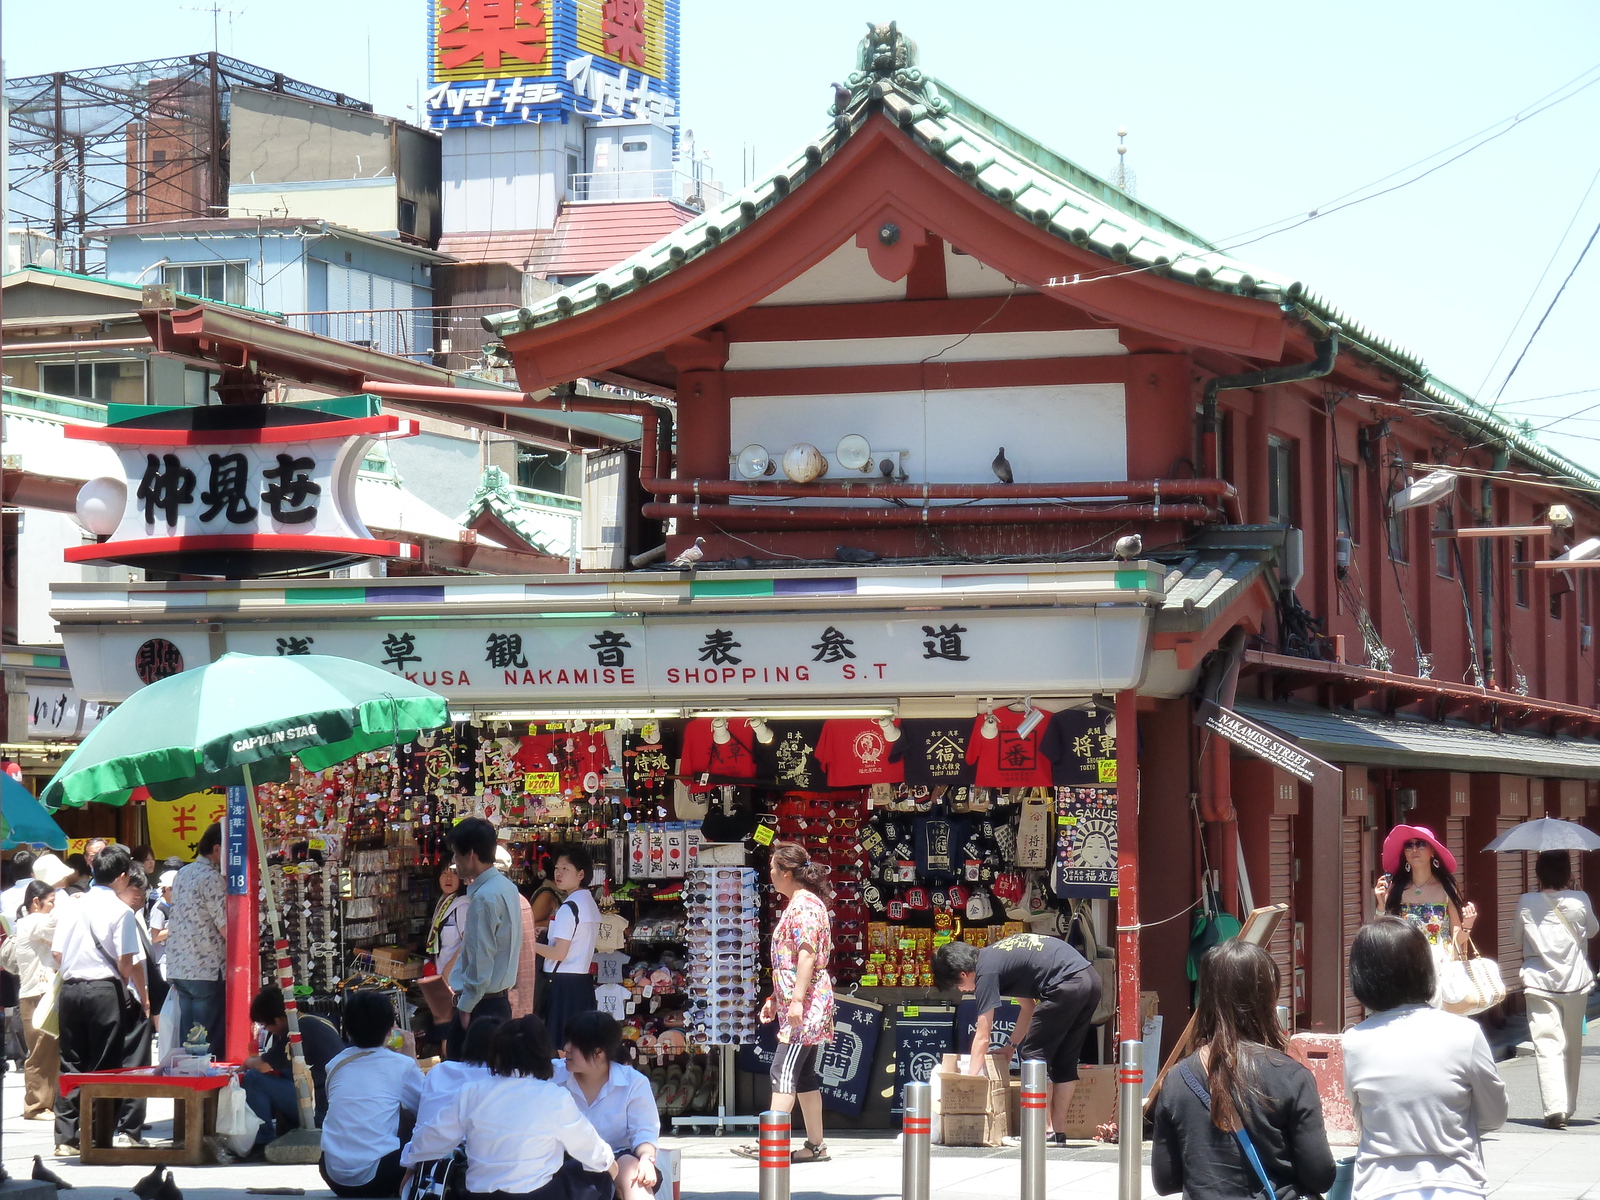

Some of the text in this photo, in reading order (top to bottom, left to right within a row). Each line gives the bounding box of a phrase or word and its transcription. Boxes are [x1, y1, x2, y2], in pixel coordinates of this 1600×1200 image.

[137, 453, 322, 527] 仲見世
[504, 668, 635, 685] NAKAMISE
[667, 665, 810, 684] SHOPPING
[233, 724, 318, 752] CAPTAIN STAG
[787, 731, 803, 740] 日本
[1219, 714, 1310, 767] NAKAMISE STREET
[935, 743, 955, 763] 福
[1001, 736, 1034, 767] 一番
[1072, 735, 1117, 758] 将軍
[232, 805, 242, 866] 浅草一丁目
[230, 874, 245, 887] 18
[852, 1009, 874, 1025] 浅草
[903, 1040, 947, 1048] 天下一品
